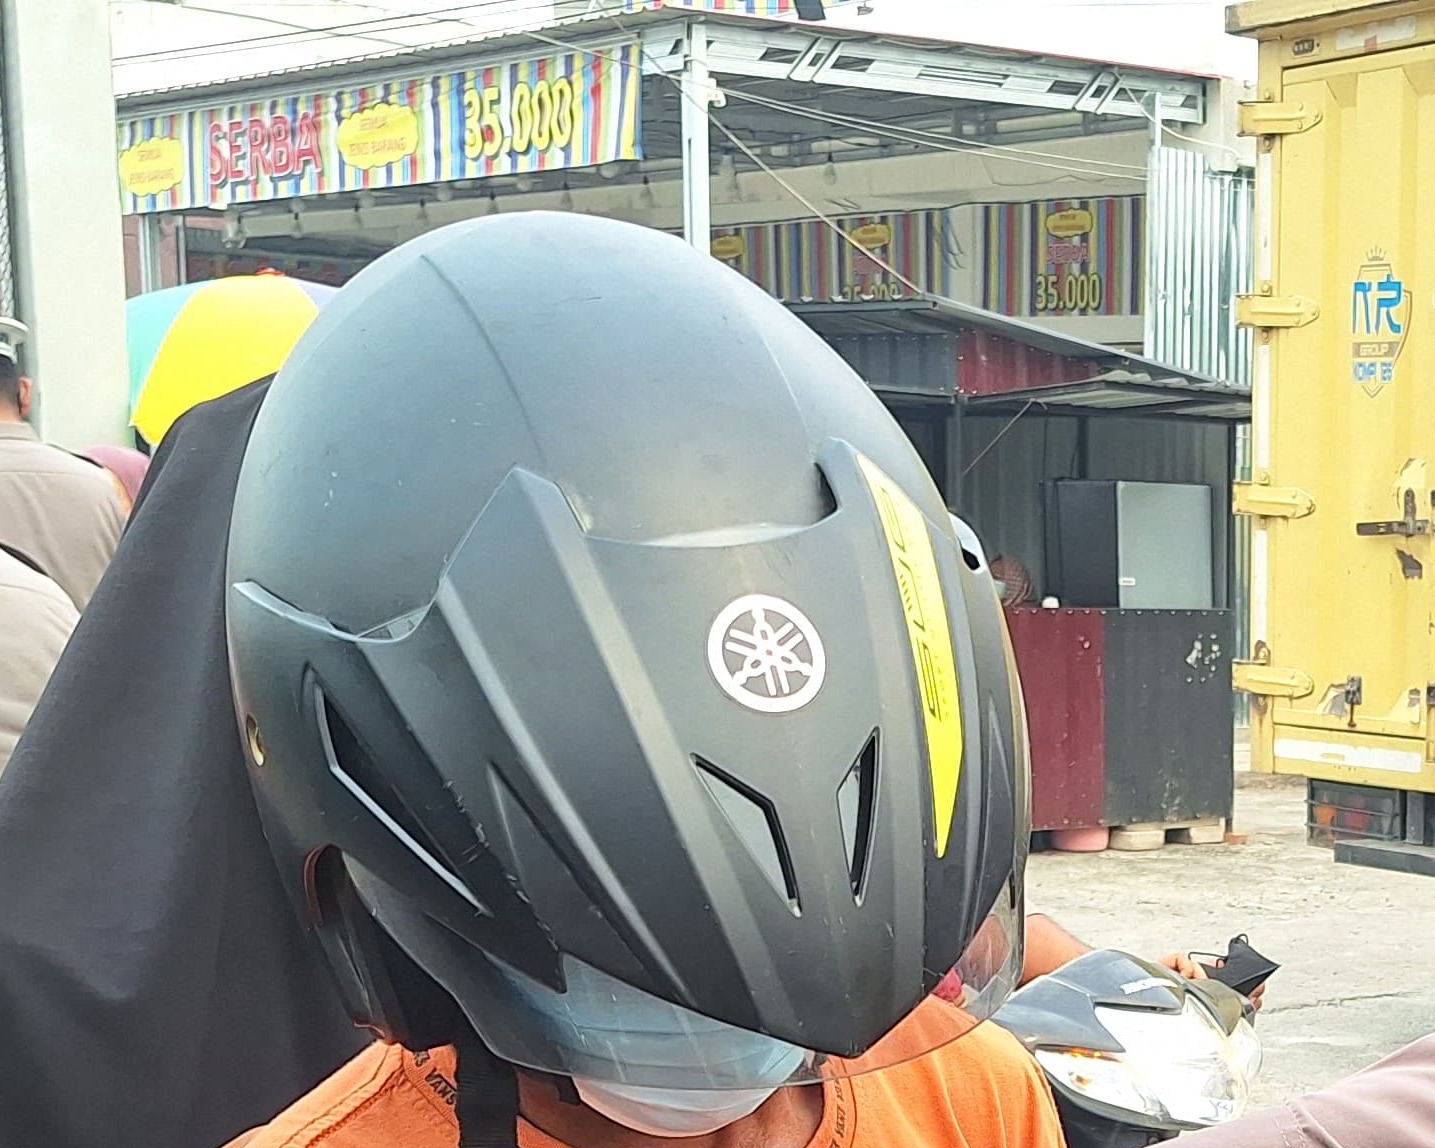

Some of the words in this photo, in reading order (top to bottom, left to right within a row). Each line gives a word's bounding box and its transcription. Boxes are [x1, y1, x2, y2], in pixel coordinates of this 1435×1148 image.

[209, 111, 323, 186] SERBA
[463, 76, 574, 160] 35.000
[1035, 273, 1101, 312] 35.000
